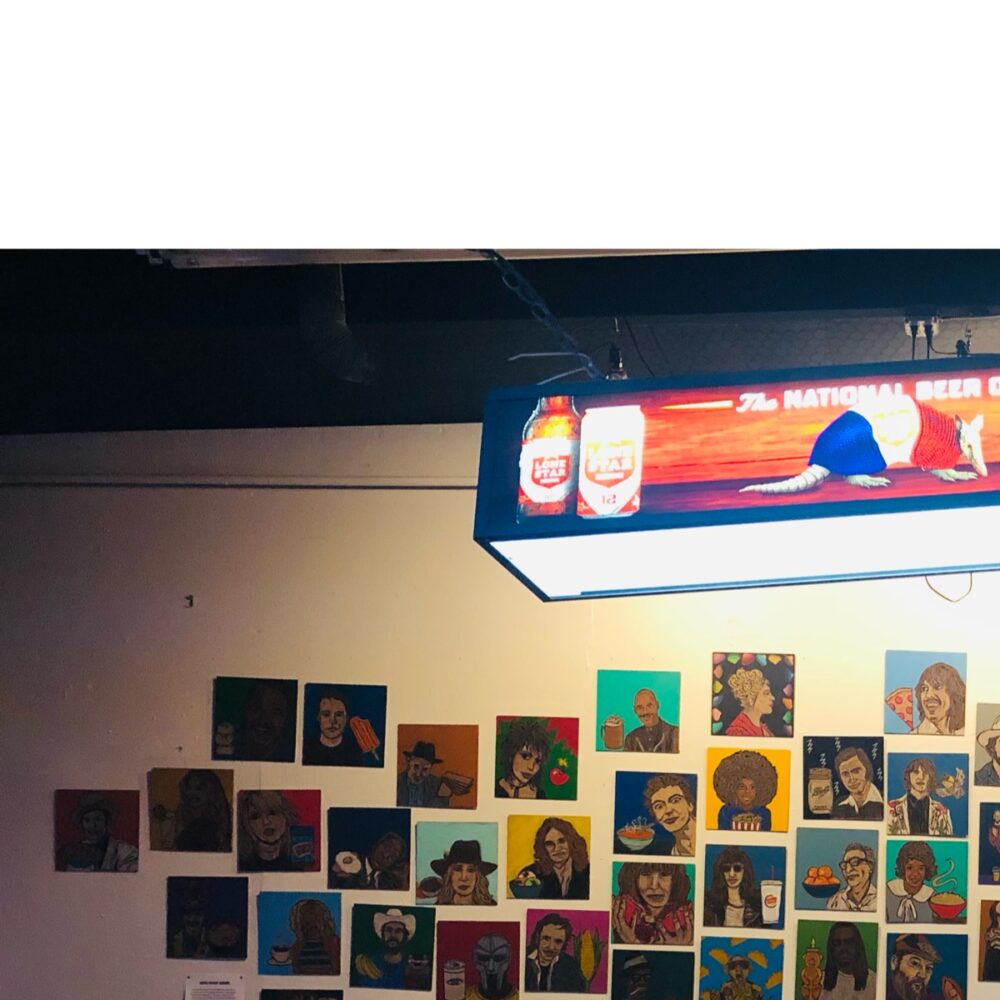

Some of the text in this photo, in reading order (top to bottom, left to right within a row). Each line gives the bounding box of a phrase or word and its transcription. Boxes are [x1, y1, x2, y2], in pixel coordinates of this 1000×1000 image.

[736, 392, 778, 413] The
[783, 383, 904, 409] NATIONAL
[916, 377, 982, 400] BEER
[534, 459, 567, 470] LONE
[534, 468, 566, 479] STAR
